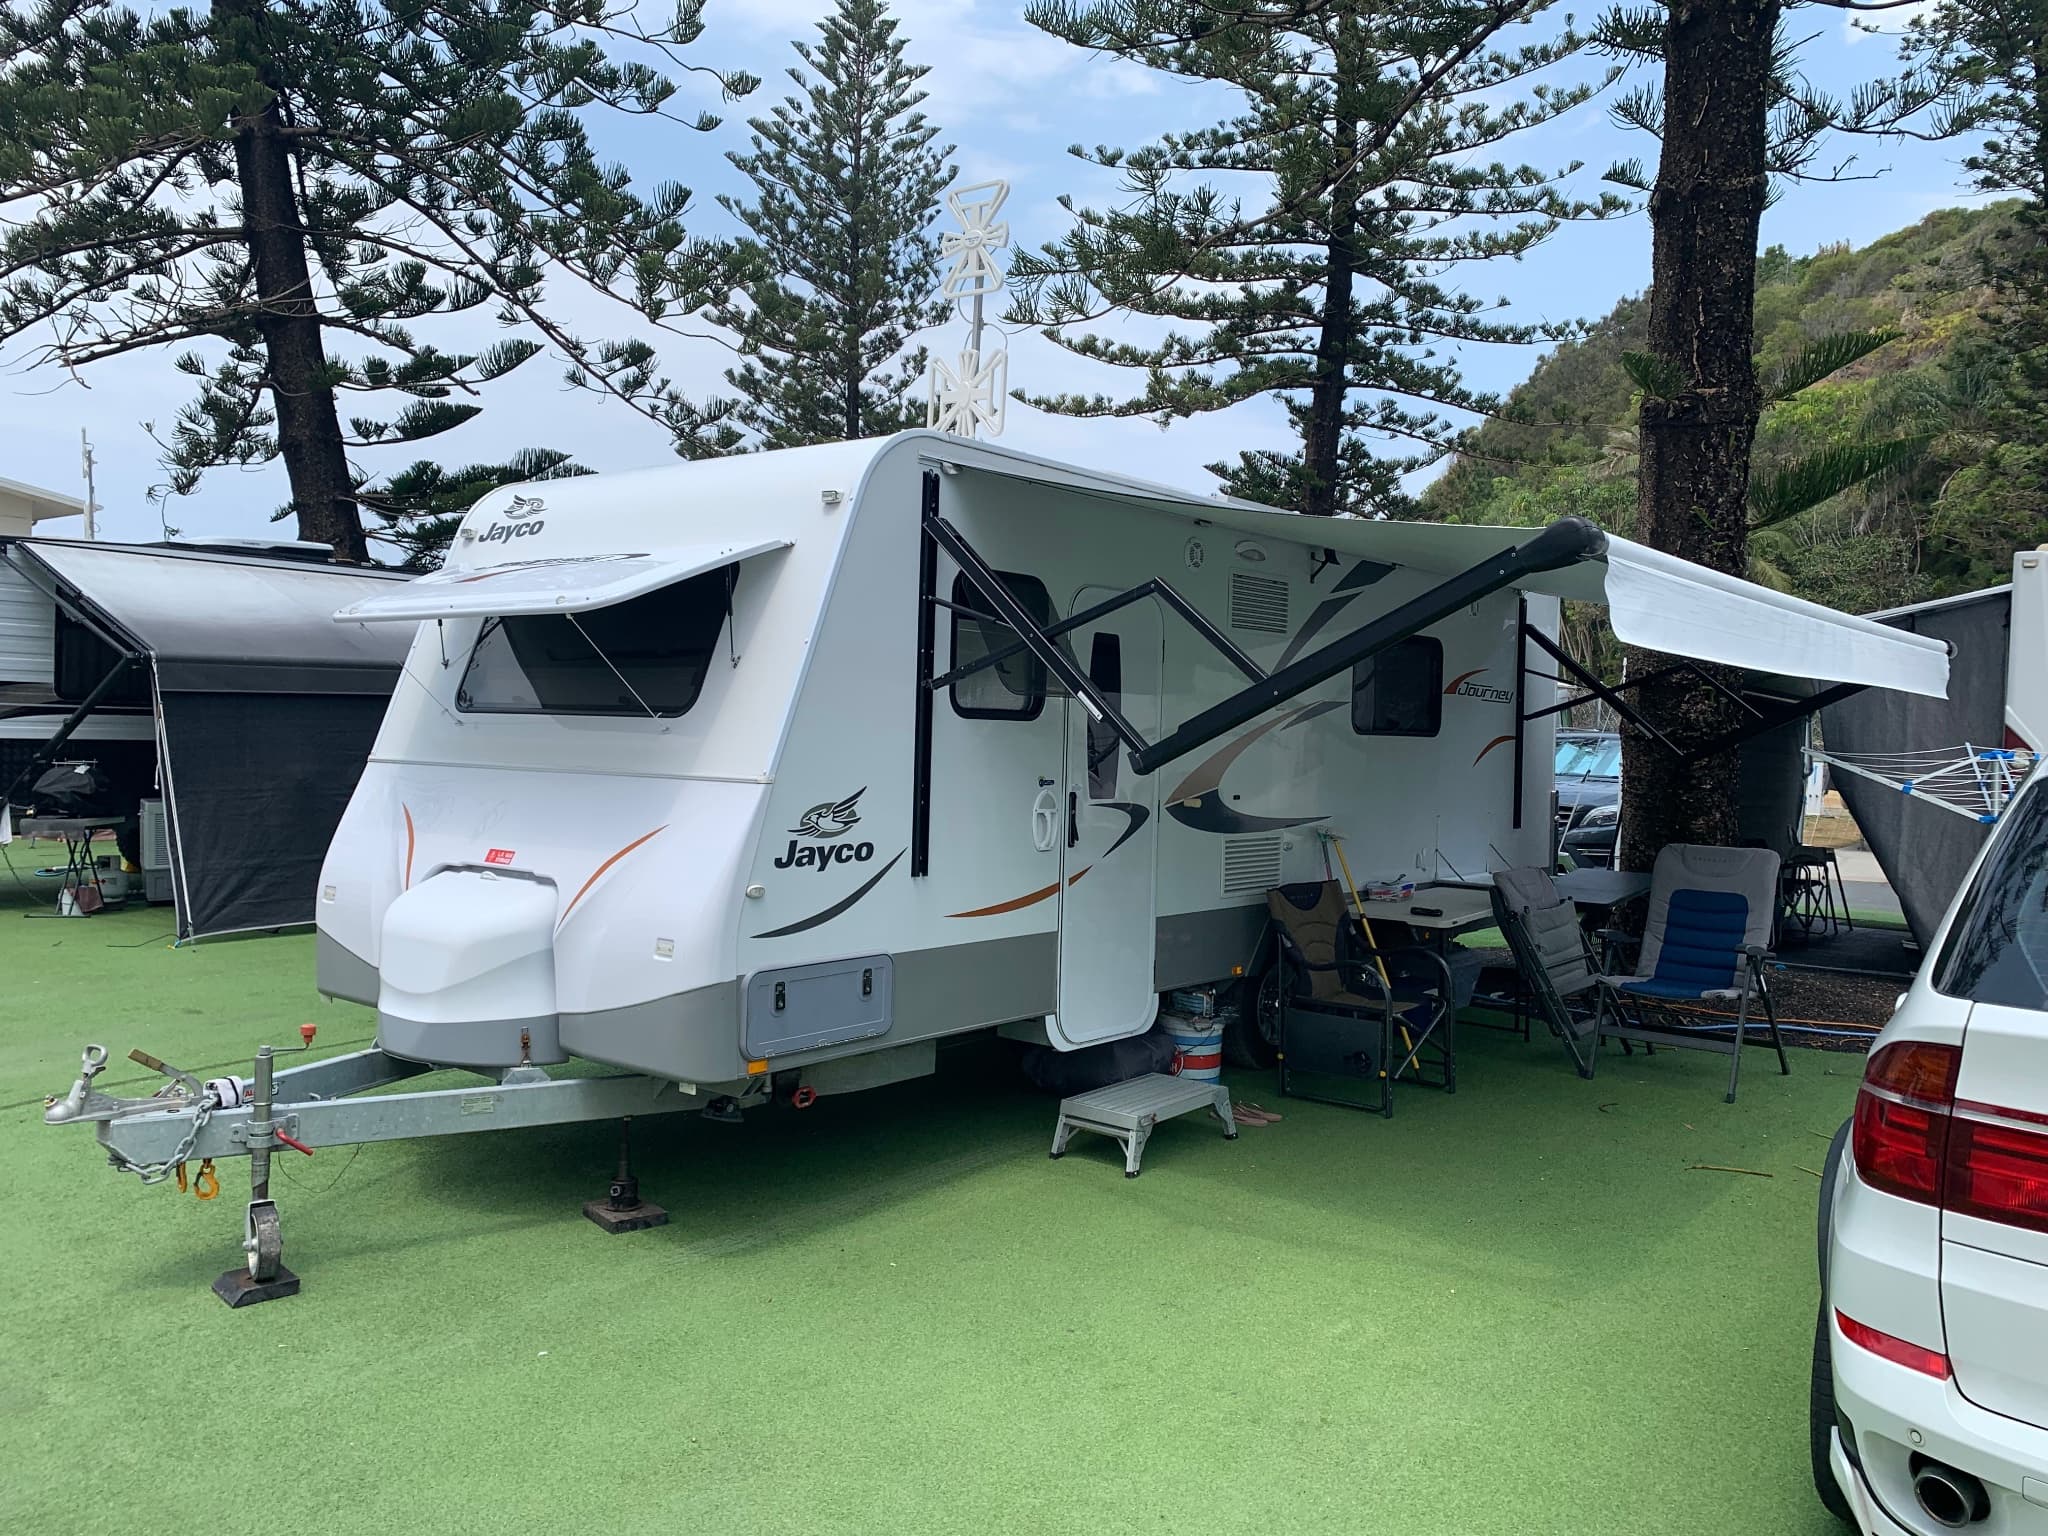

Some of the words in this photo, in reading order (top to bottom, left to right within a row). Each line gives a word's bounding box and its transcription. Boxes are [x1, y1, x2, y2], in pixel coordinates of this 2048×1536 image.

[478, 520, 544, 544] Jayco
[1457, 681, 1514, 704] Journey
[774, 839, 875, 872] Jayco
